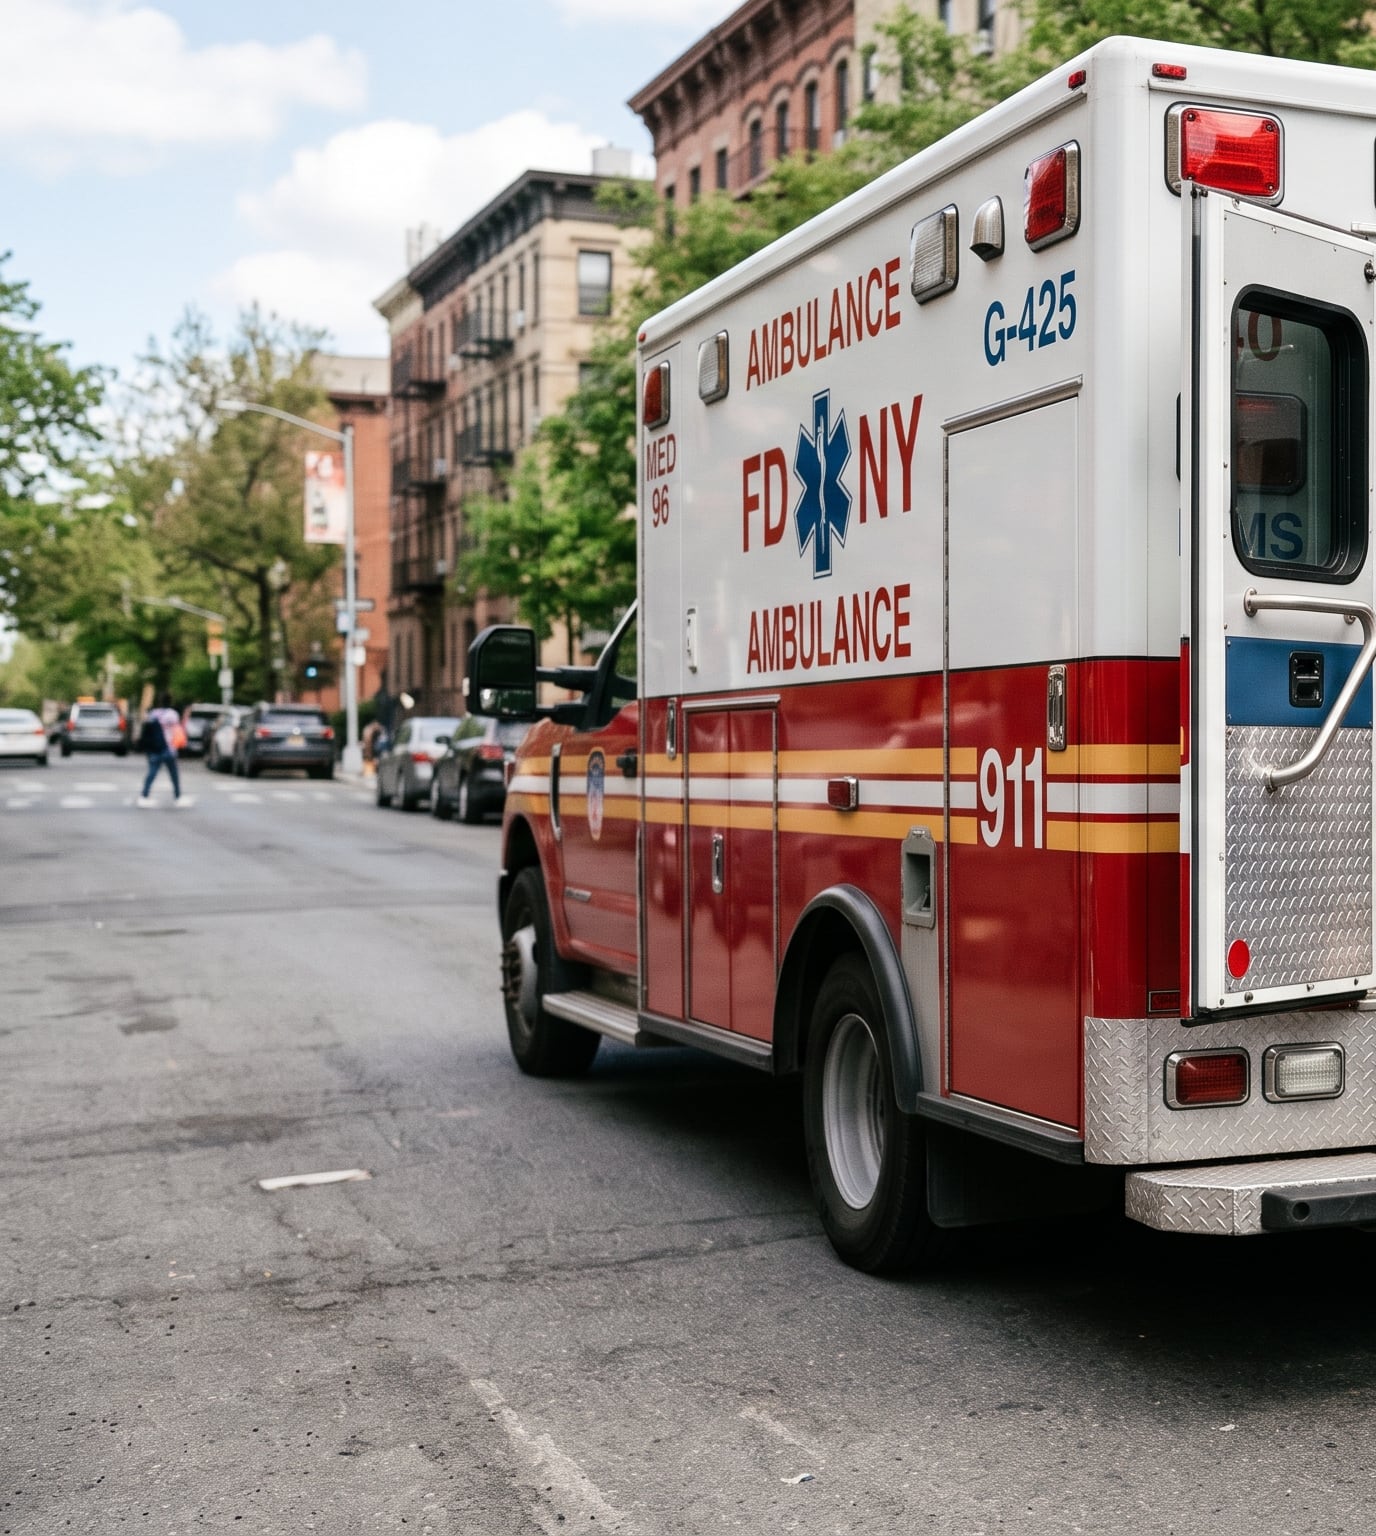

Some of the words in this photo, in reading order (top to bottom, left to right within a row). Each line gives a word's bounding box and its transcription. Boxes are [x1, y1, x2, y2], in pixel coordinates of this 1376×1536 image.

[746, 257, 901, 391] AMBULANCE
[984, 269, 1077, 367] G-425
[647, 433, 676, 482] MED
[652, 484, 669, 528] 96
[1240, 511, 1304, 560] MS
[747, 584, 911, 675] AMBULANCE
[980, 747, 1043, 849] 911
